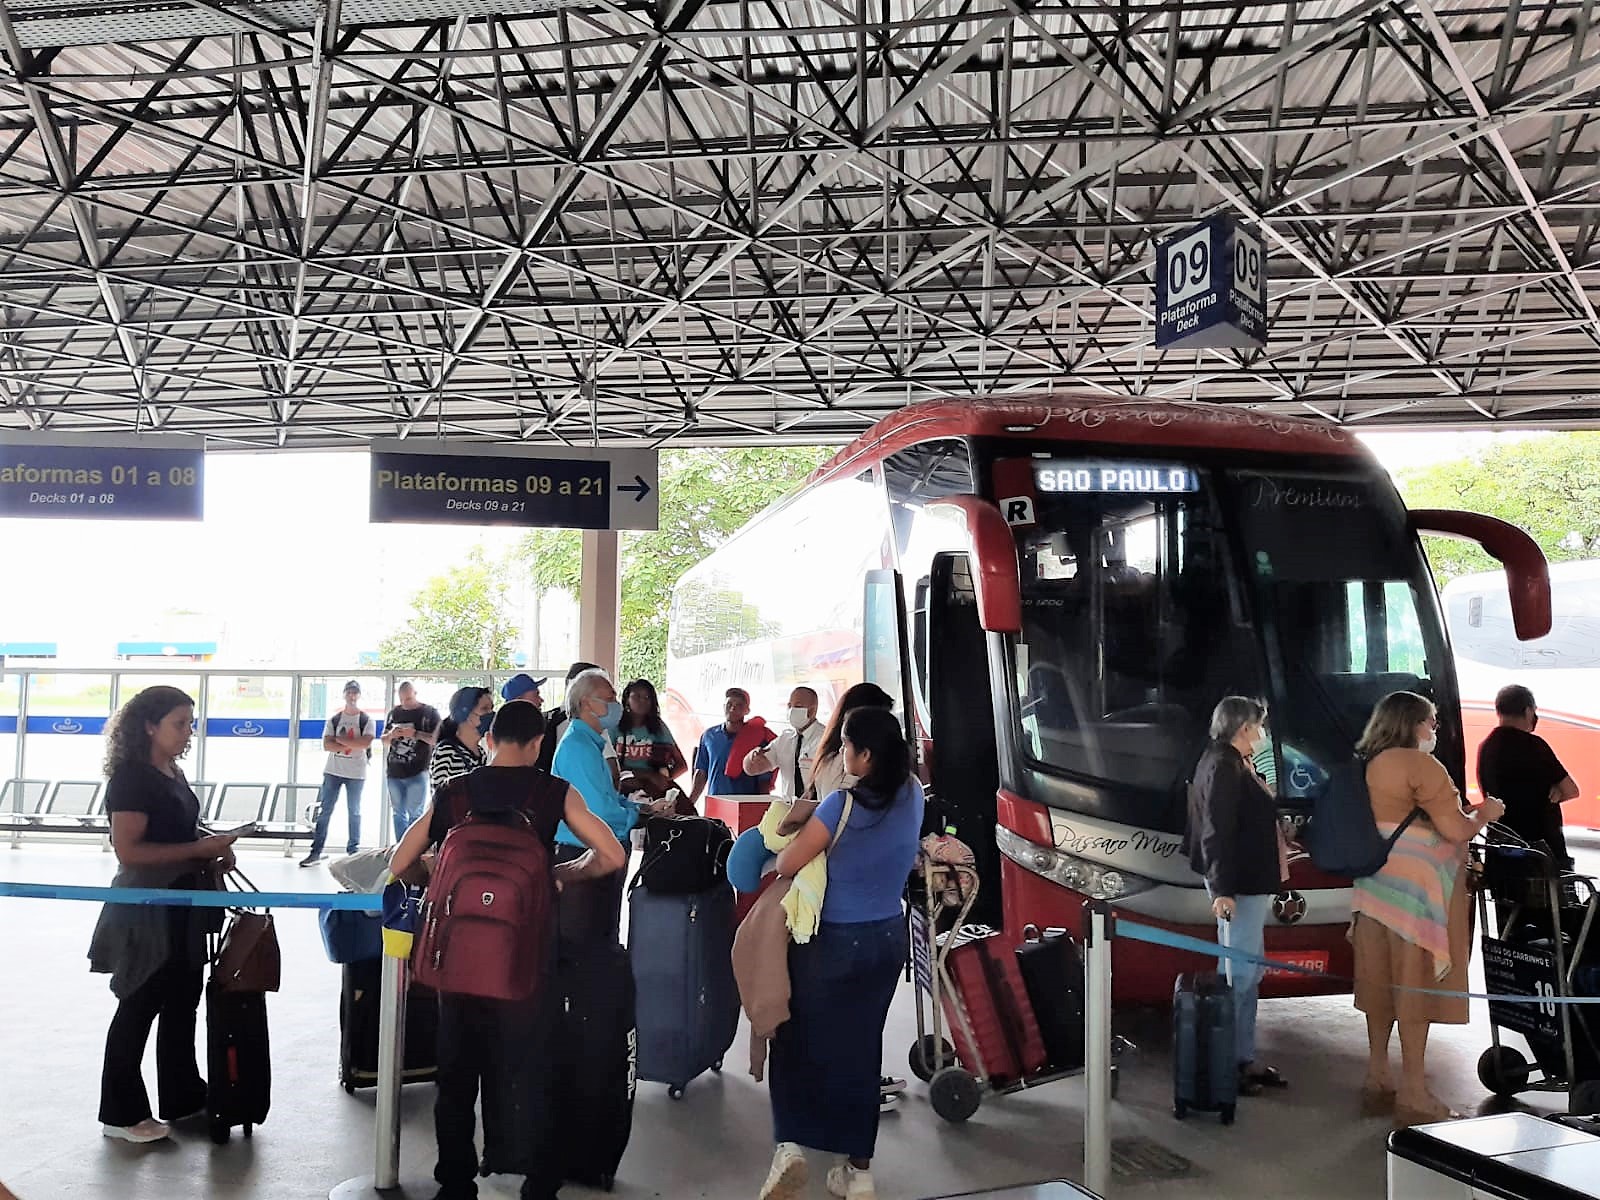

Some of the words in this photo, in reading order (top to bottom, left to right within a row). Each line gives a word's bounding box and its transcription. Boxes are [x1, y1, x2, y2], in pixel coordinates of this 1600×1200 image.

[1170, 240, 1209, 295] 09
[1236, 239, 1259, 292] 09
[1161, 292, 1217, 326] Plataforma
[1230, 289, 1264, 324] Plataforma
[1176, 315, 1199, 332] Deck
[0, 463, 104, 484] aformas
[111, 465, 138, 486] 01
[147, 471, 161, 486] a
[169, 467, 196, 486] 08
[377, 470, 518, 494] Plataformas
[525, 475, 552, 495] 09
[559, 481, 572, 495] a
[578, 477, 603, 496] 21
[1039, 469, 1091, 492] SAO
[1101, 469, 1185, 492] PAULO
[30, 492, 66, 504] Decks
[70, 493, 85, 504] 01
[88, 496, 95, 504] a
[99, 493, 115, 504] 08
[1252, 476, 1361, 509] Premium
[446, 499, 482, 511] Decks
[484, 500, 499, 511] 09
[501, 504, 509, 512] a
[511, 501, 526, 512] 21
[1007, 501, 1027, 522] R
